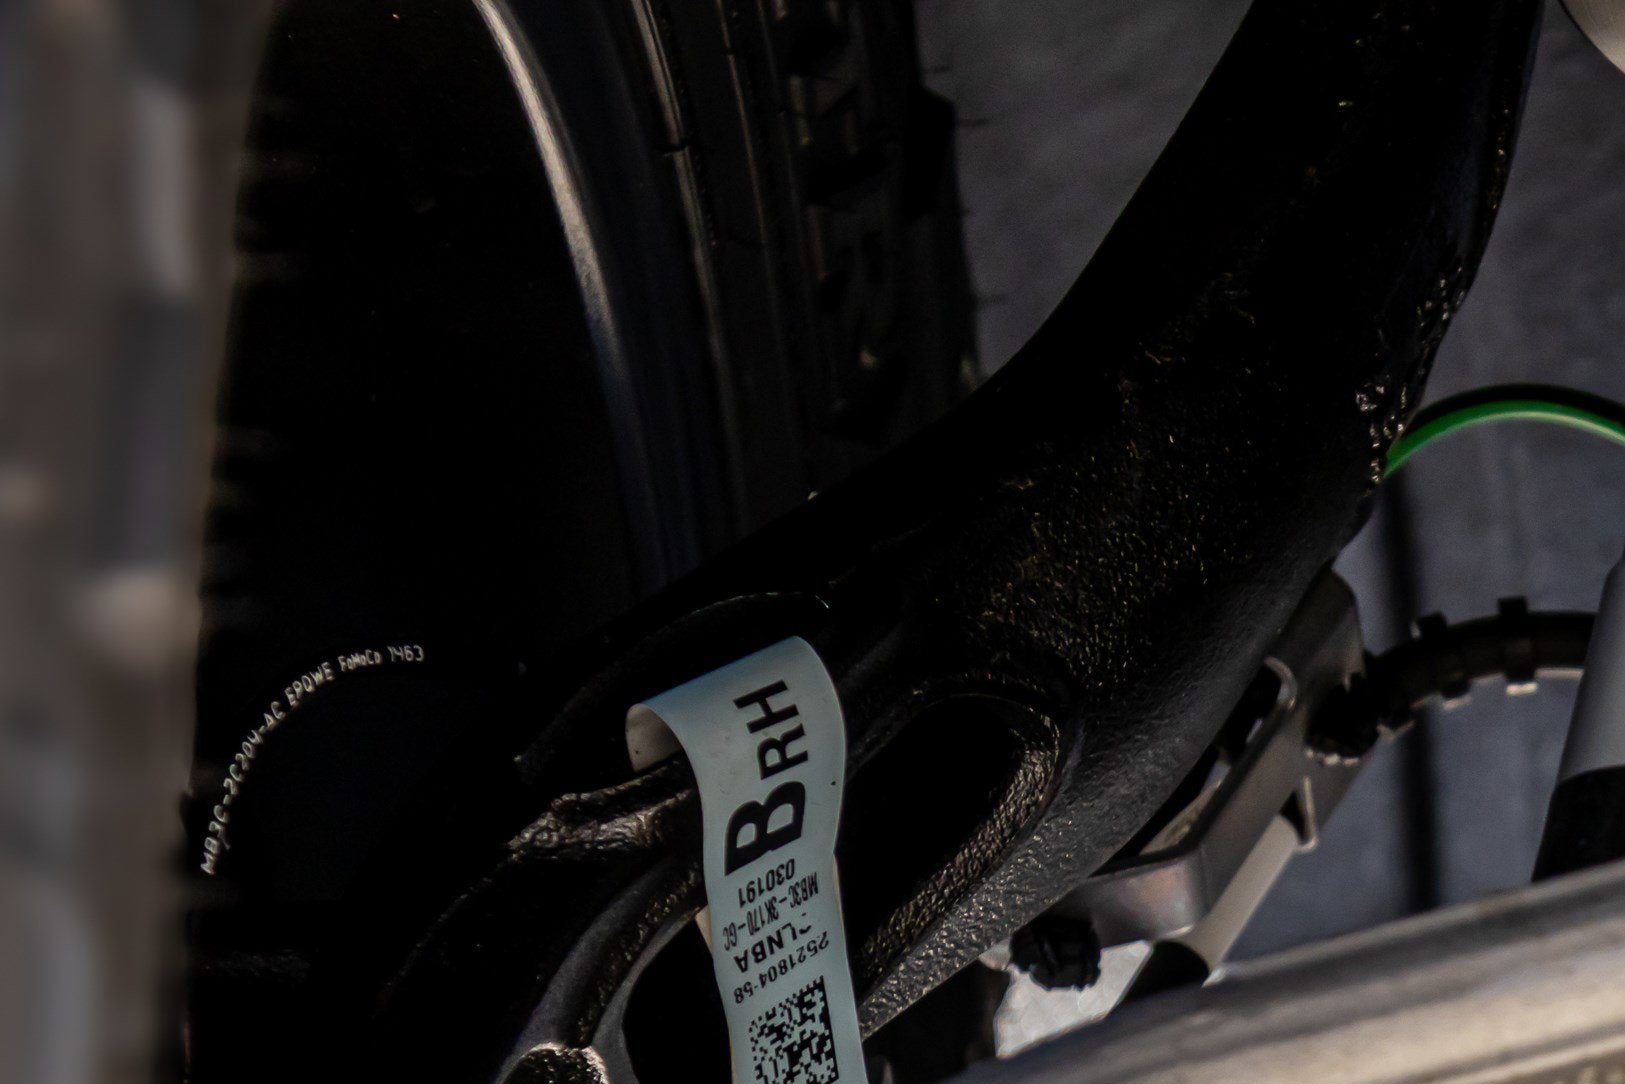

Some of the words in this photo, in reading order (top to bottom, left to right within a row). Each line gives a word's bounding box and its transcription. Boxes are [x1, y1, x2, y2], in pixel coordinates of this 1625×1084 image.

[733, 679, 808, 780] RH
[724, 781, 806, 876] B
[738, 858, 795, 908] 030191
